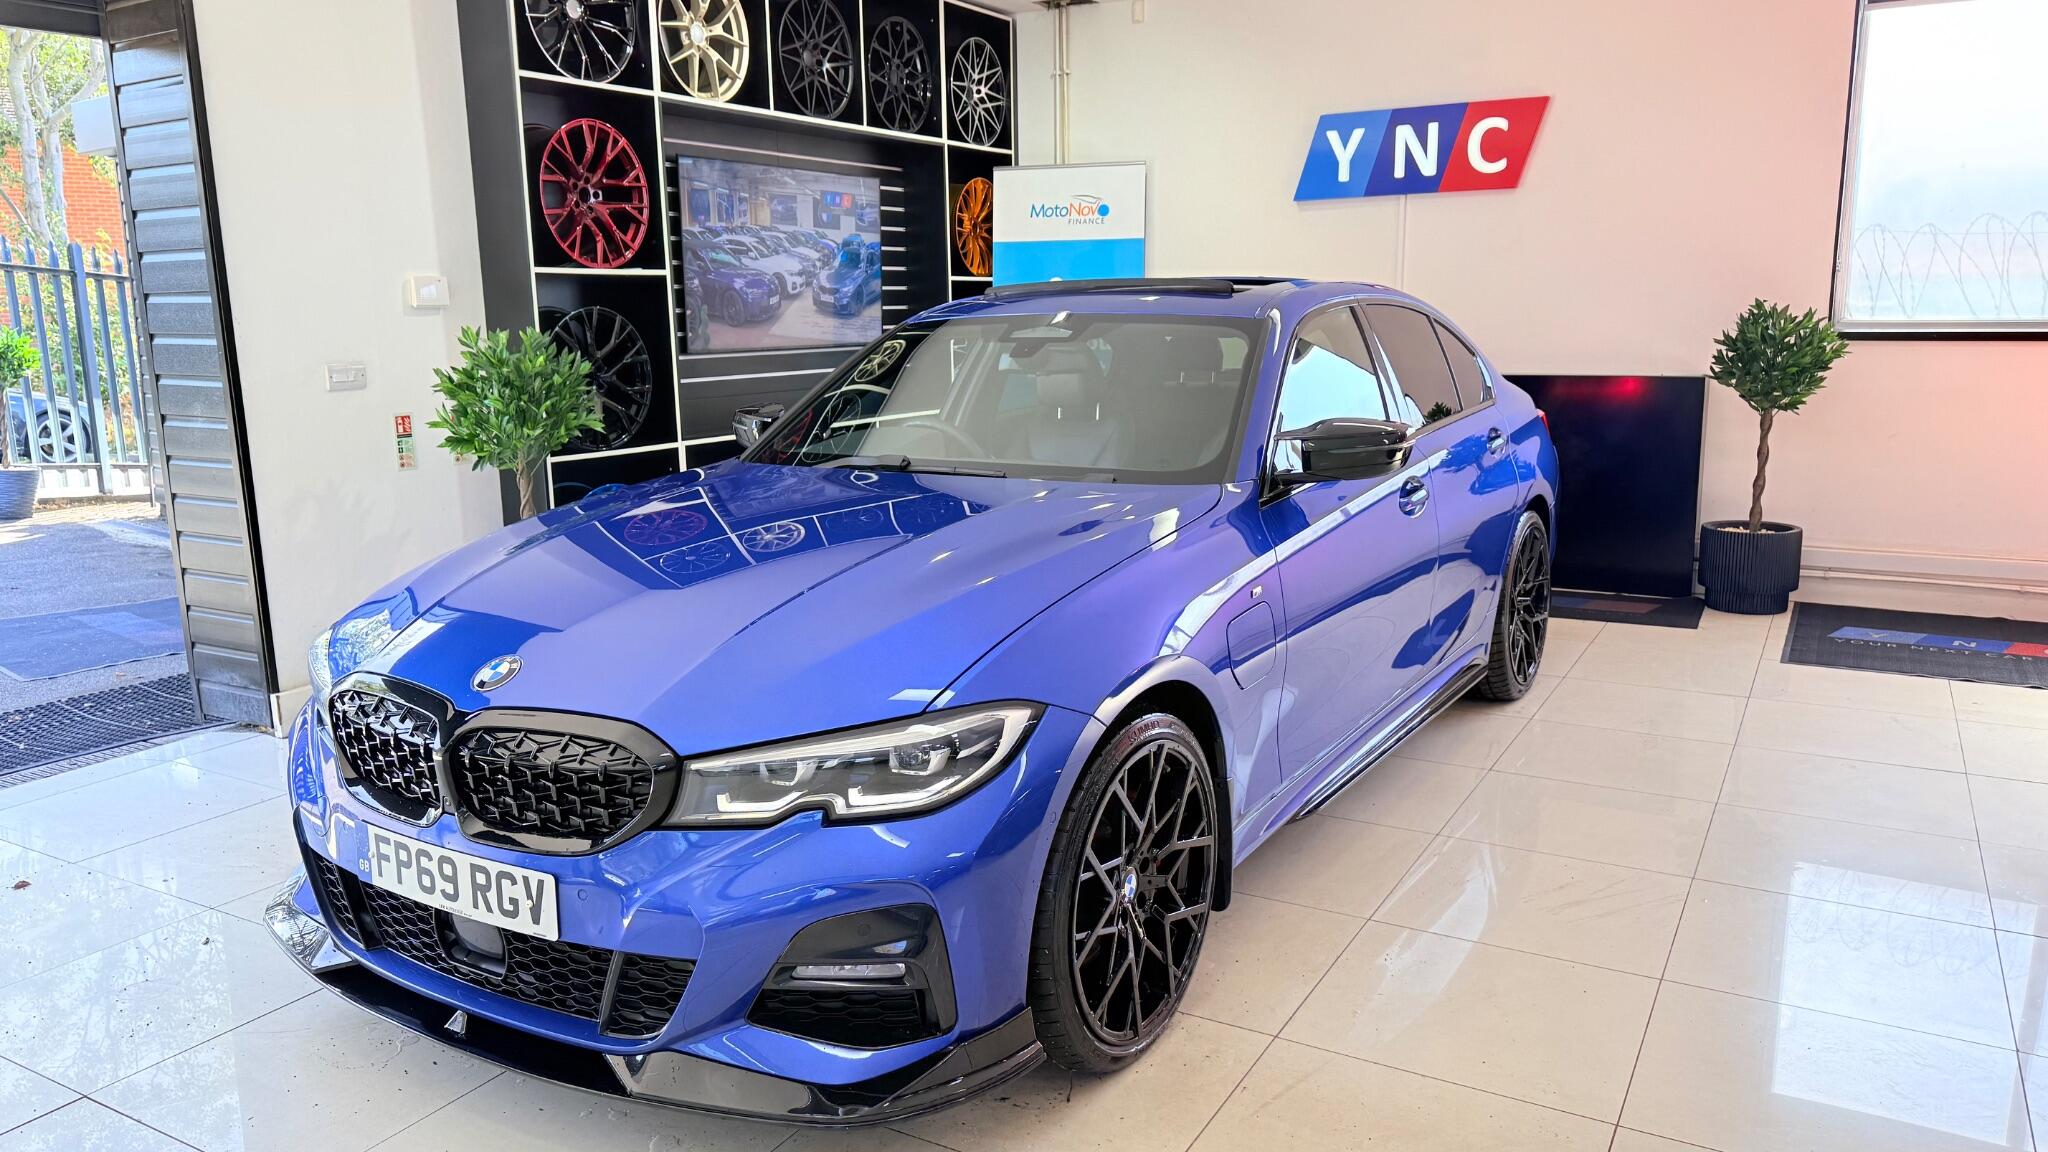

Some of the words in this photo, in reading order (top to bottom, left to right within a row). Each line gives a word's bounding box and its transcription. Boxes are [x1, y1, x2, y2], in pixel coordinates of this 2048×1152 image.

[1326, 116, 1509, 183] YNC
[1834, 638, 1897, 648] YOUR
[1911, 645, 1972, 655] NEXT
[1985, 652, 2033, 660] CAR
[359, 858, 370, 873] GB
[374, 832, 460, 903] FP69
[469, 862, 545, 926] RGV
